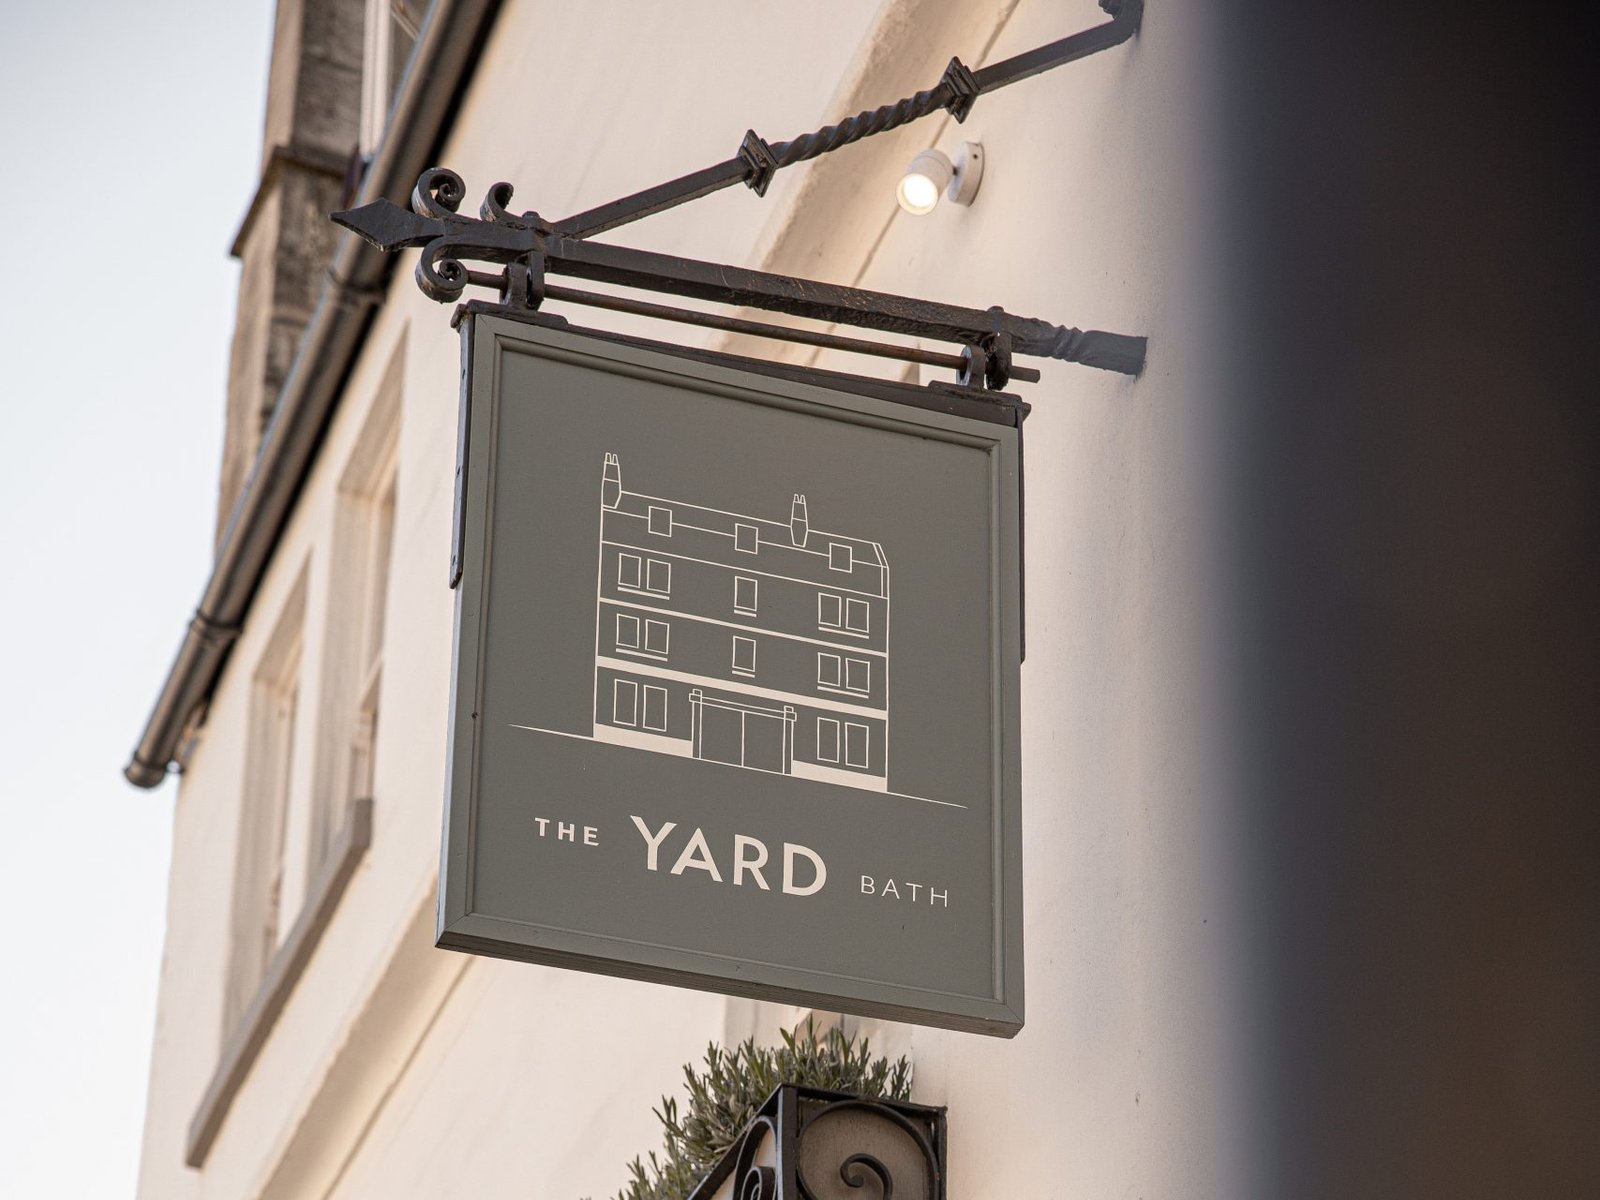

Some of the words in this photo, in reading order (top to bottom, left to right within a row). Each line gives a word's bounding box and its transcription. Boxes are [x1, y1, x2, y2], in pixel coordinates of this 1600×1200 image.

[534, 817, 600, 847] THE
[629, 814, 828, 897] YARD
[860, 874, 949, 908] BATH
